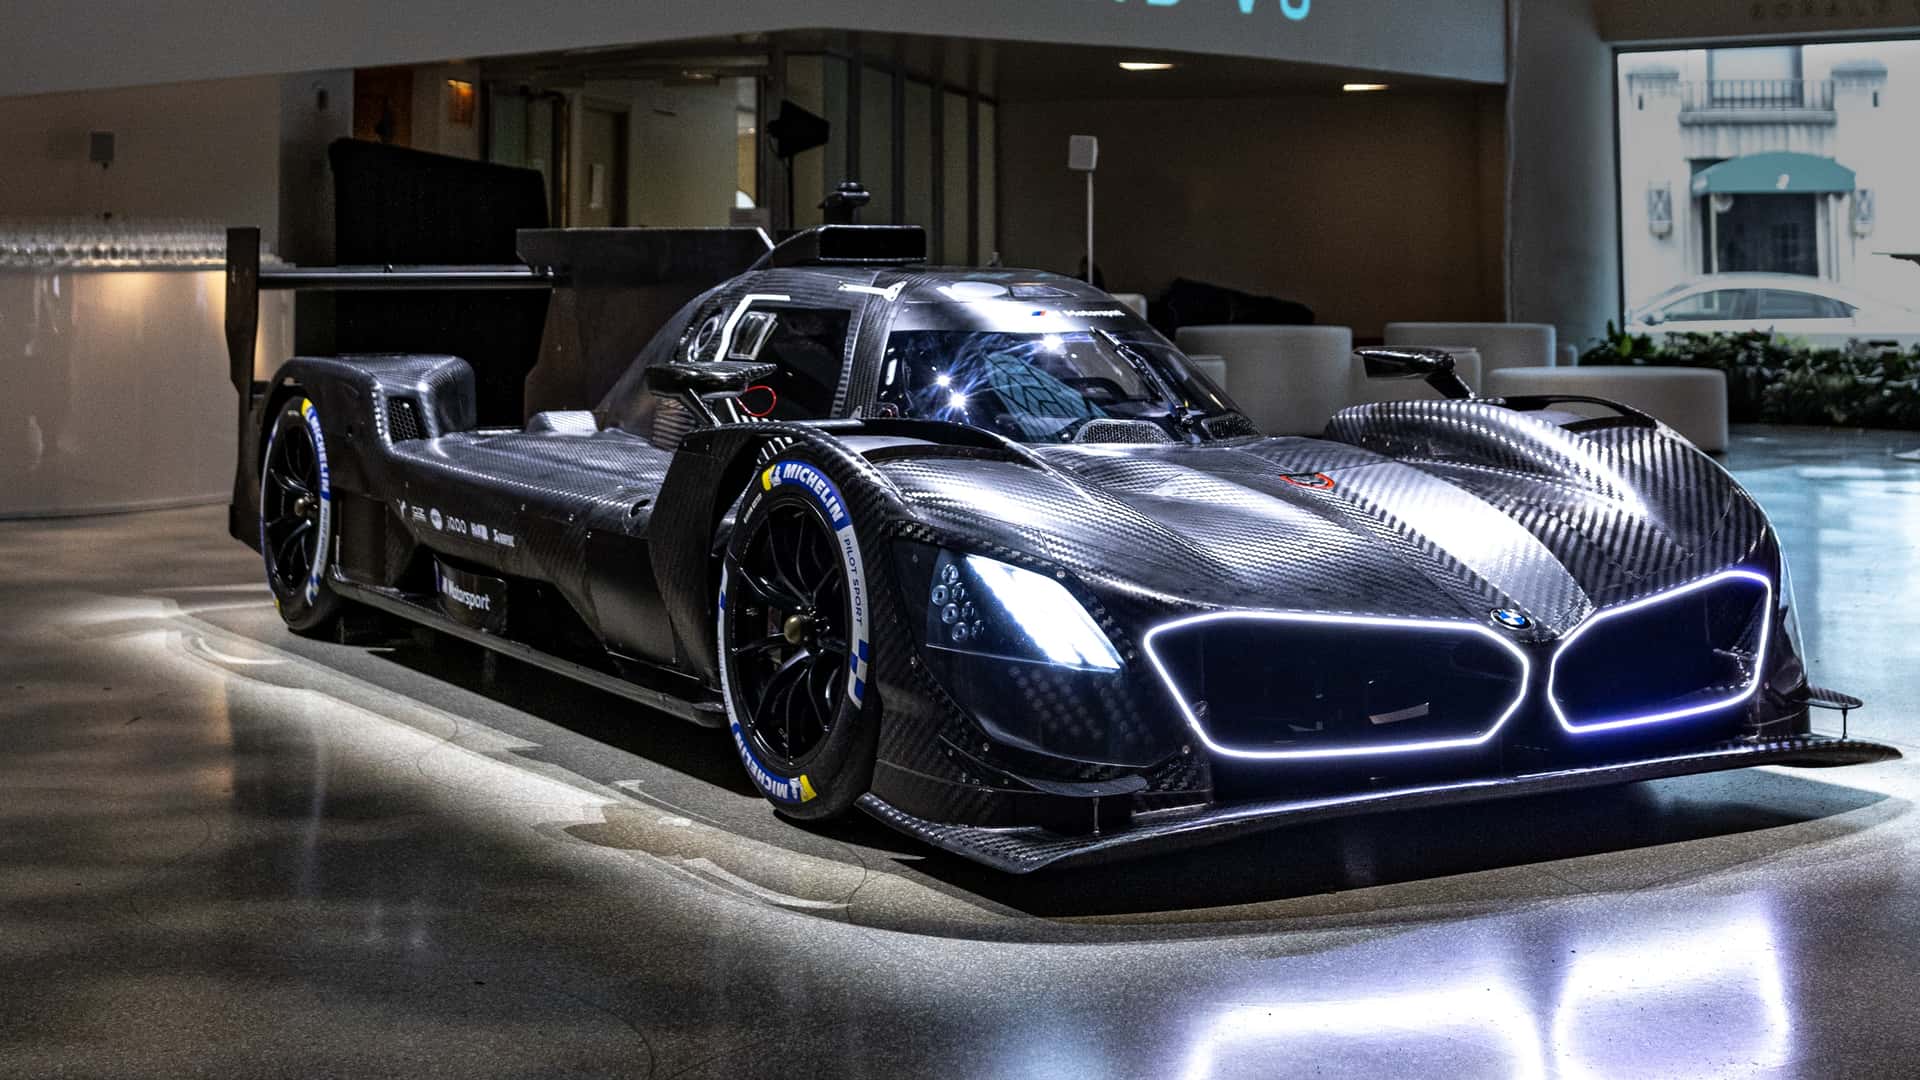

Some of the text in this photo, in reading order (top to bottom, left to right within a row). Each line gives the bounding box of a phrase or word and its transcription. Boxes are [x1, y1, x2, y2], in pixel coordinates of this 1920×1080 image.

[308, 414, 329, 493] MICHELIN
[783, 463, 844, 523] MICHELIN
[843, 538, 863, 625] PILOT SPORT
[735, 732, 788, 799] MICHELIN
